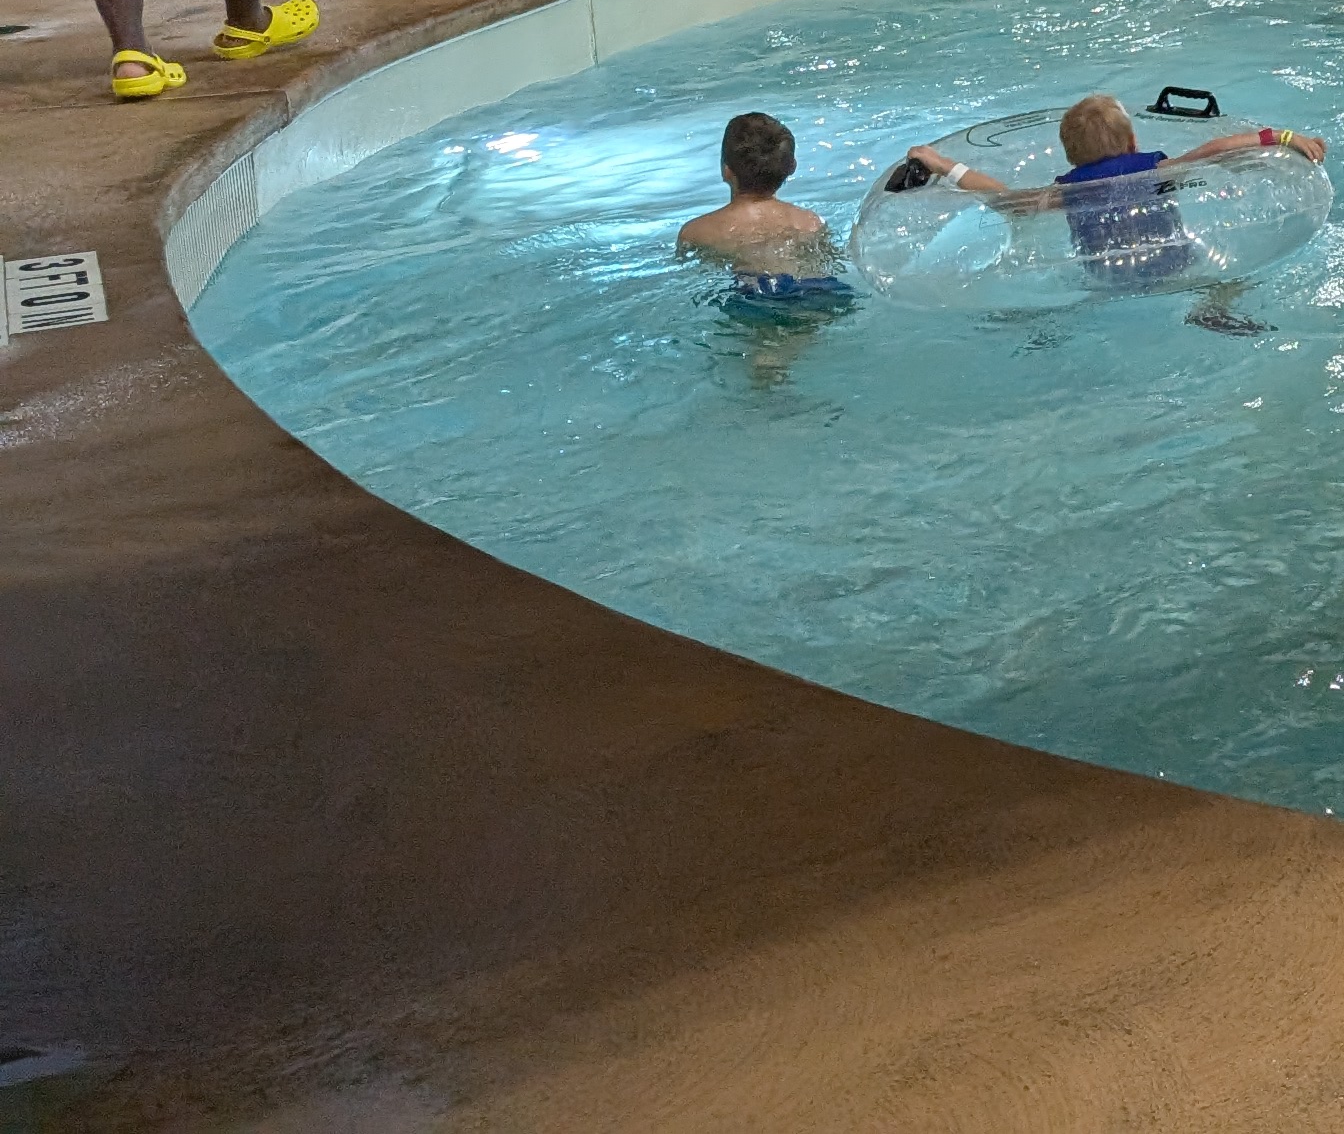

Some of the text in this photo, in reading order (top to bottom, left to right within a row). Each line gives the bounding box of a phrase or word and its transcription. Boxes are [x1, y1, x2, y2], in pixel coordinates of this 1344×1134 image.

[18, 257, 85, 272] 3
[18, 270, 89, 291] FT
[20, 306, 95, 330] IN
